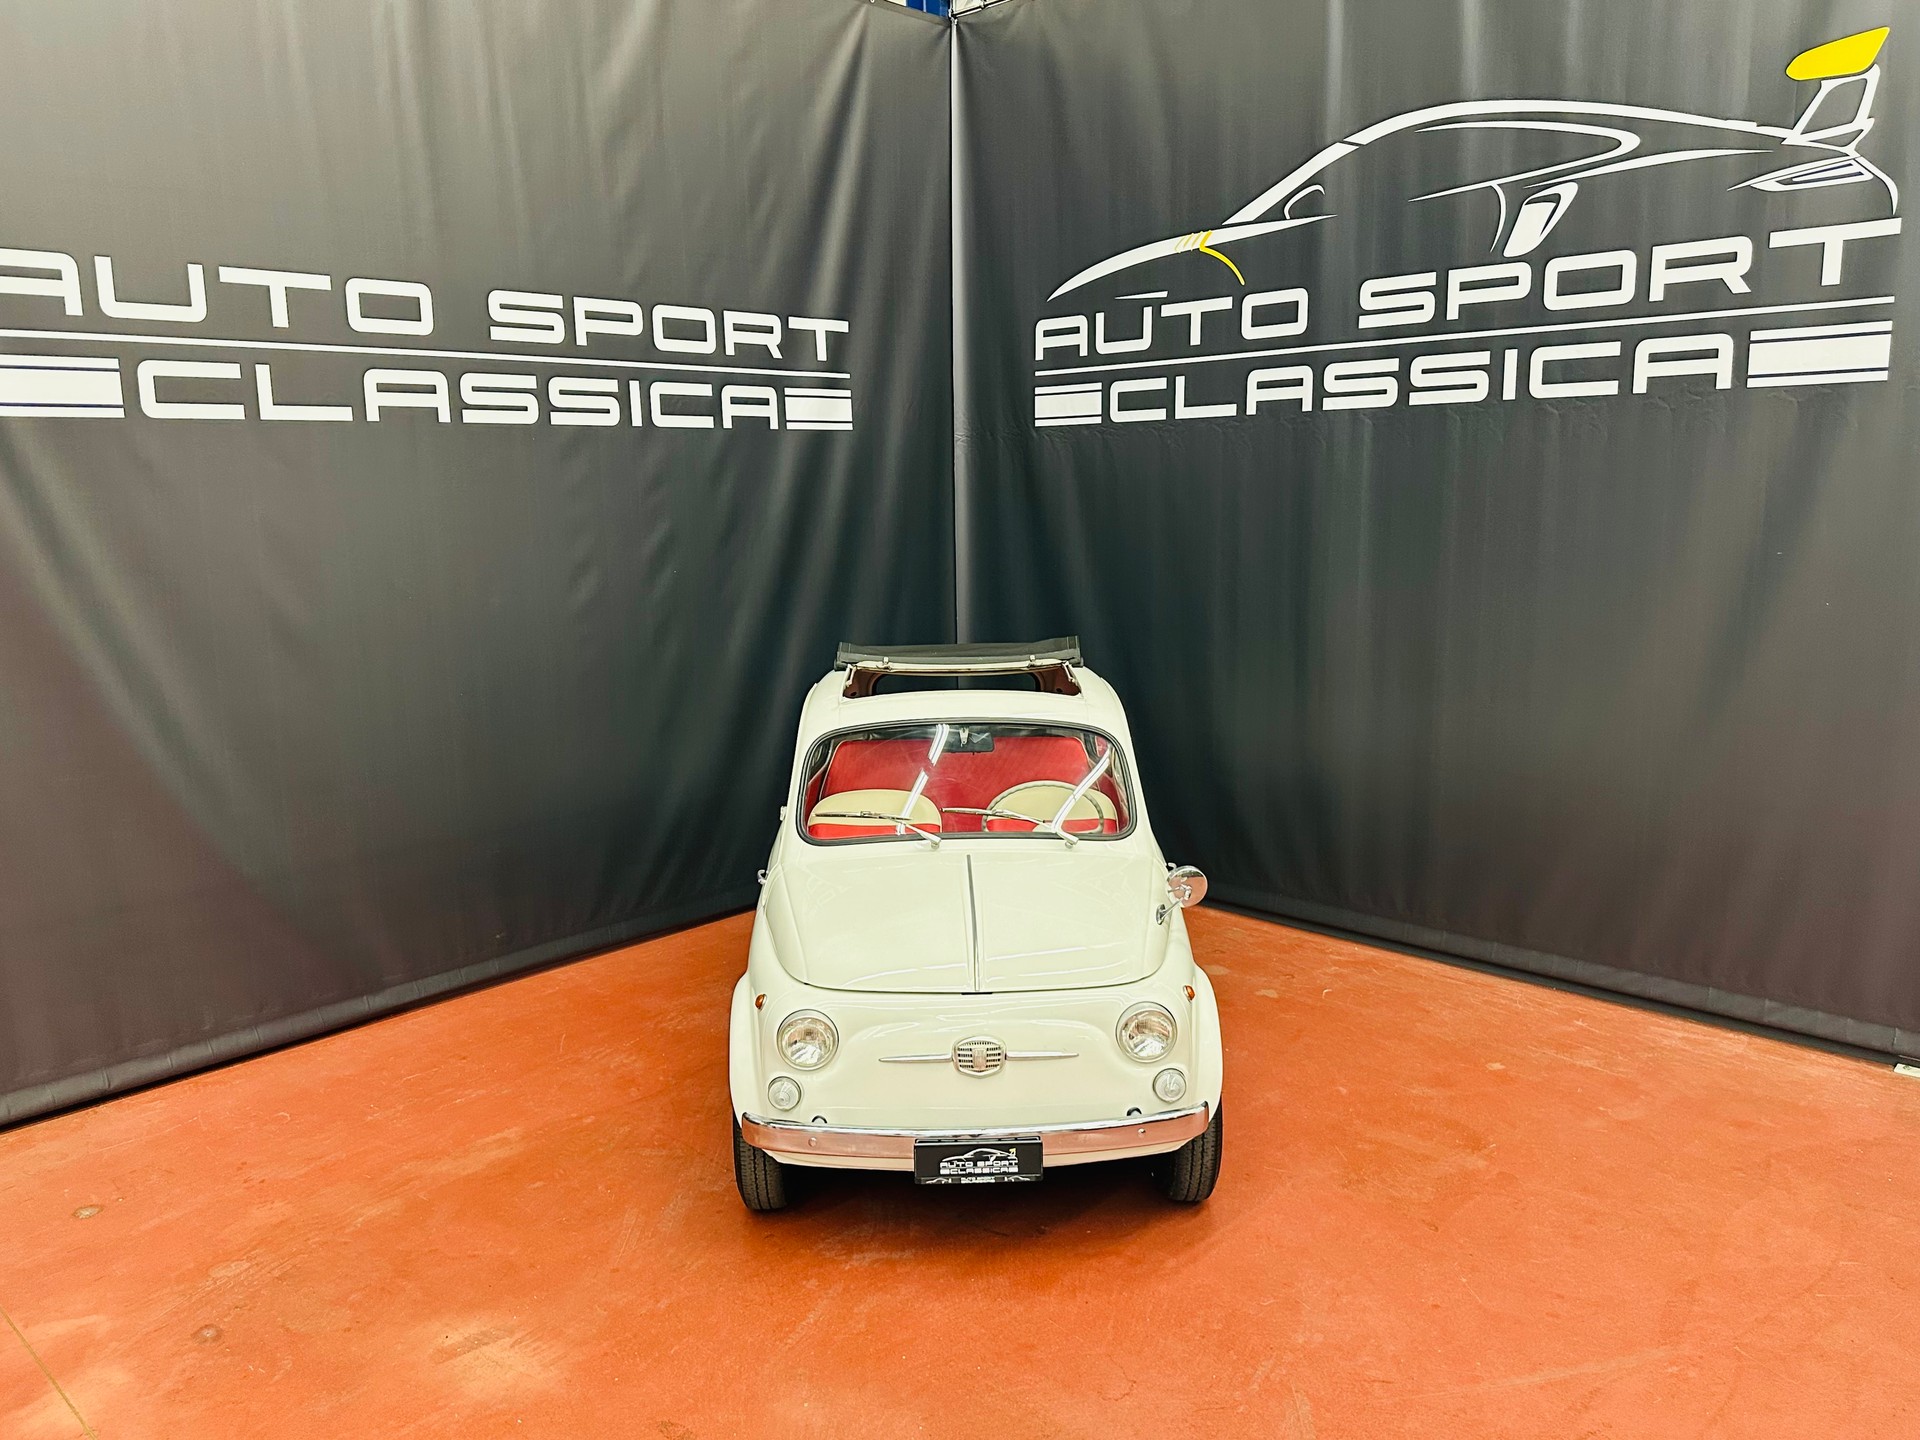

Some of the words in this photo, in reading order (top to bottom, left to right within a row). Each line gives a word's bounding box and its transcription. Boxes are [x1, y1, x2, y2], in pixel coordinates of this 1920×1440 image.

[0, 248, 434, 336] AUTO
[487, 289, 849, 362] SPORT
[1035, 287, 1309, 361] AUTO
[1358, 217, 1902, 329] SPORT
[137, 359, 779, 430] CLASSICA
[1109, 333, 1734, 423] CLASSICA
